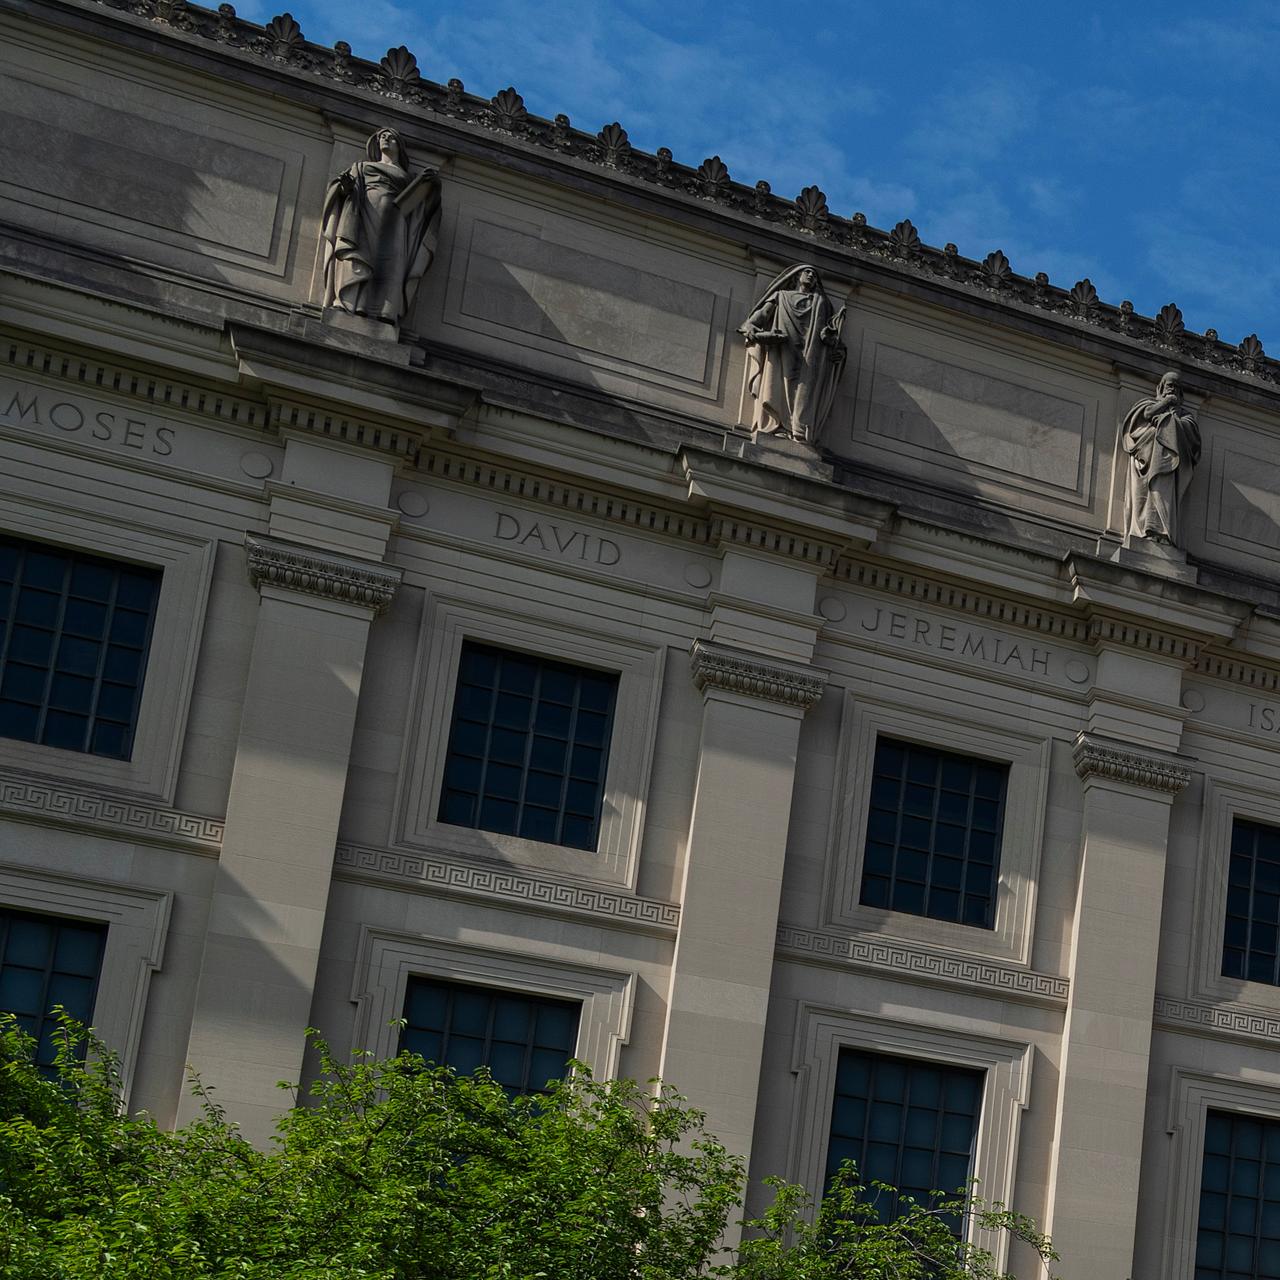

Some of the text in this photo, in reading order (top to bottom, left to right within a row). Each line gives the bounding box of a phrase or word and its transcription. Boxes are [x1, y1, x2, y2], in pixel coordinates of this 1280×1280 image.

[1, 391, 175, 456] MOSES
[493, 511, 621, 566] DAVID
[861, 607, 1052, 675] JEREMIAH
